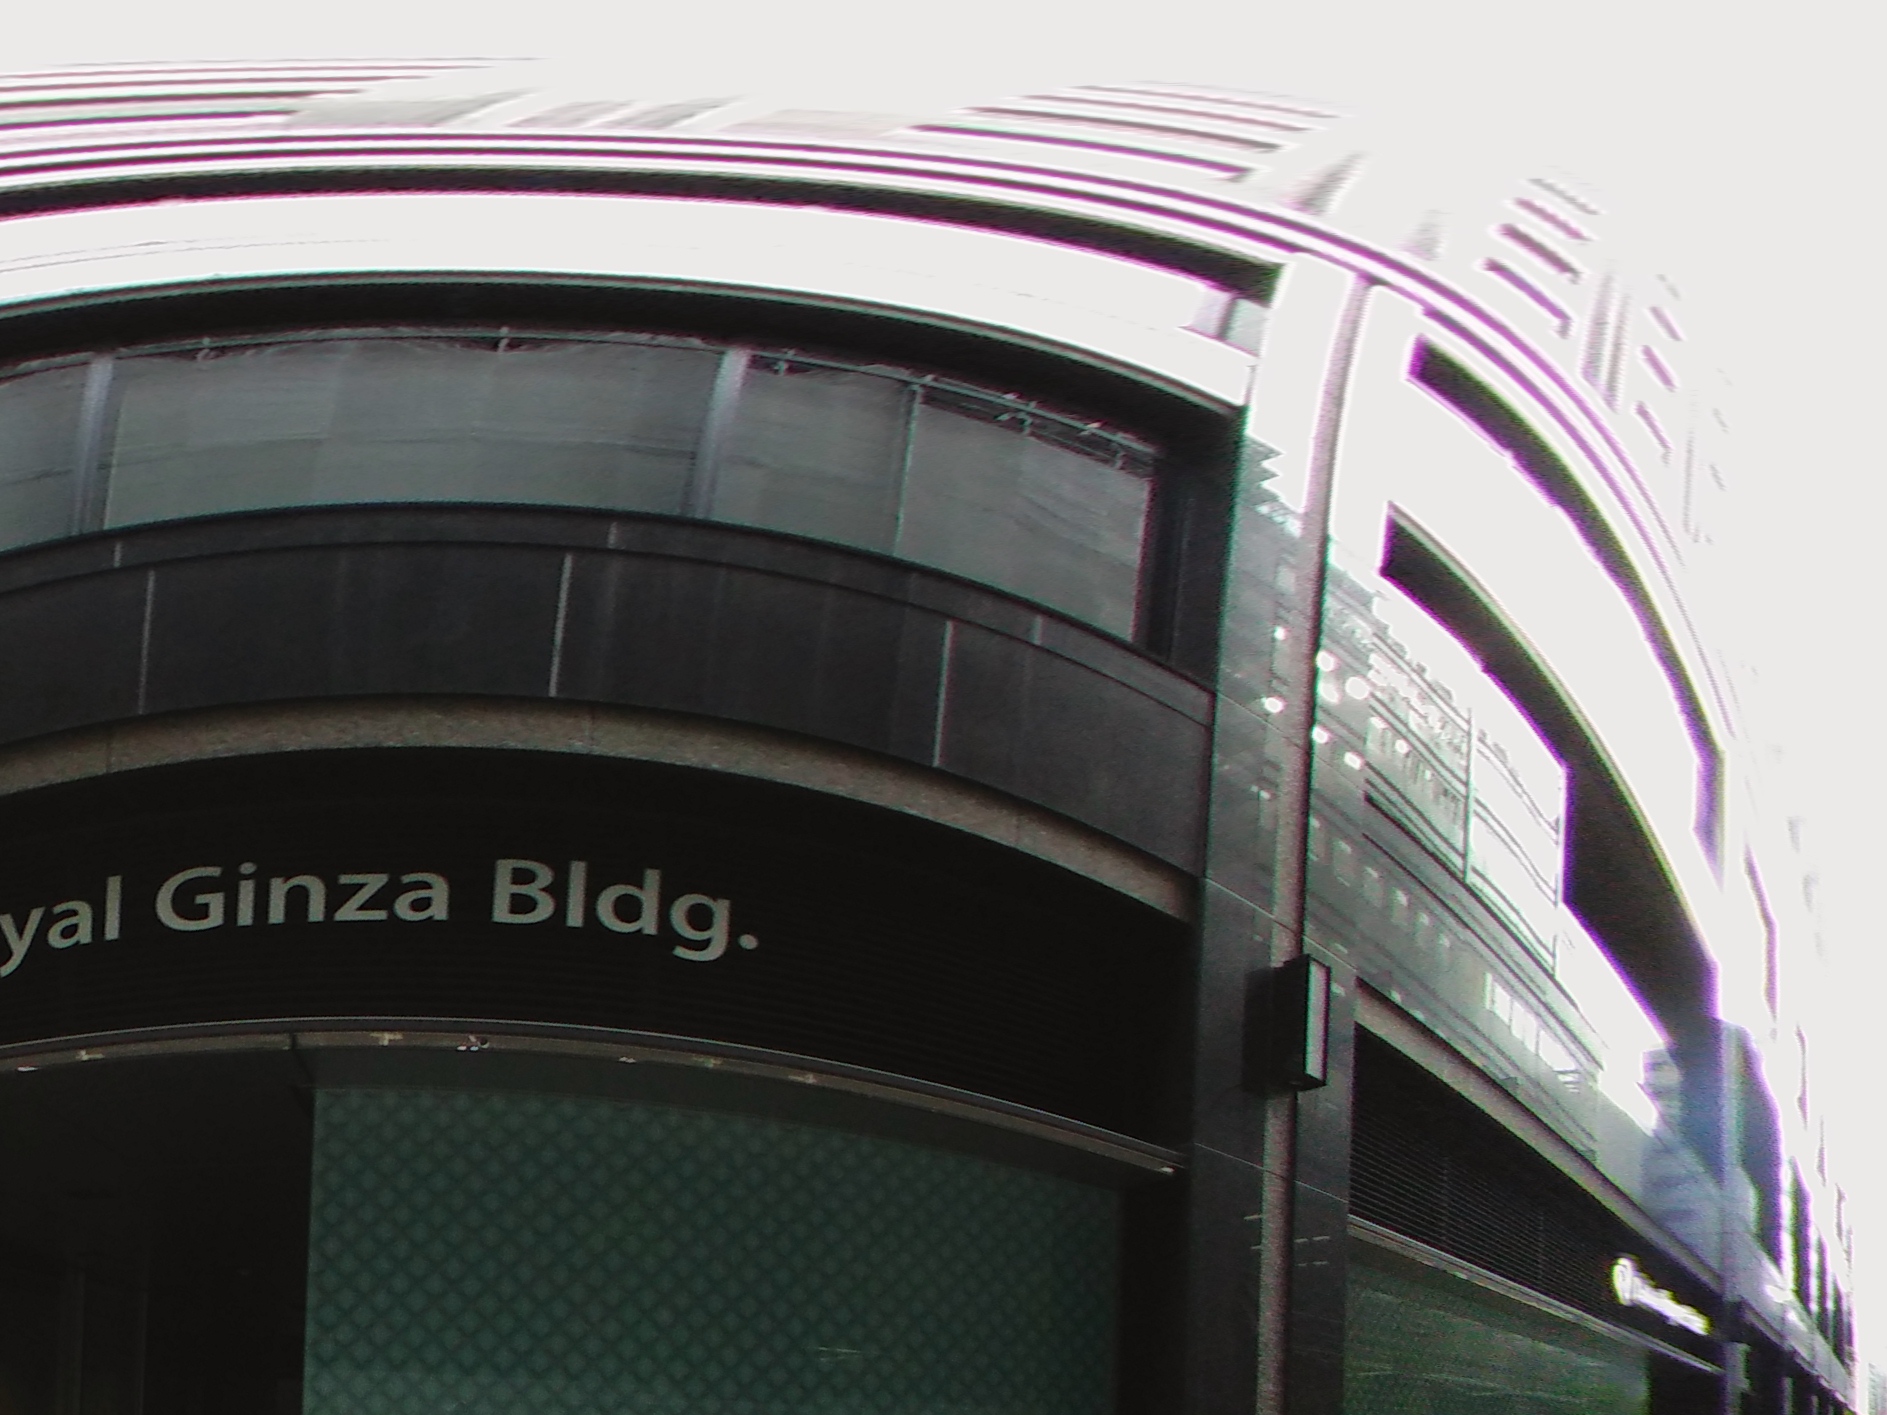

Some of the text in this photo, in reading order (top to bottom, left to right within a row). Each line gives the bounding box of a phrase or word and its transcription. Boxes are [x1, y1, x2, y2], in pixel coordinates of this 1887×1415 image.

[0, 859, 759, 978] yal Ginza Bldg.
